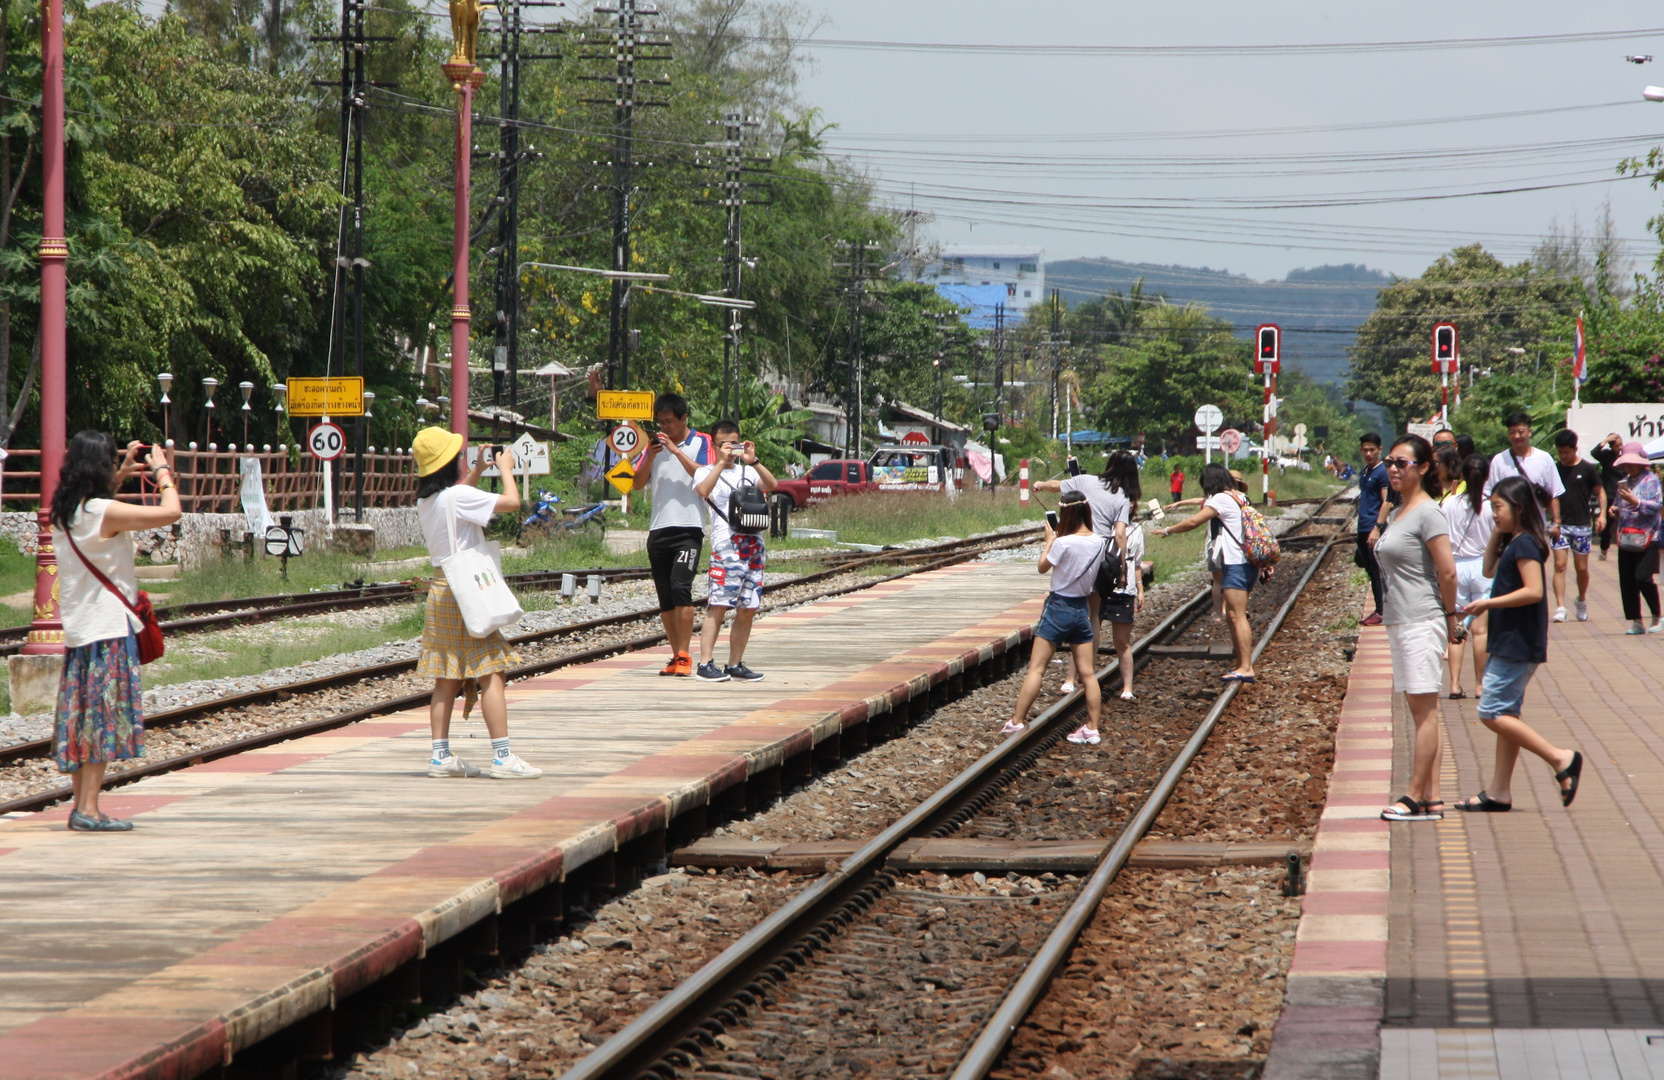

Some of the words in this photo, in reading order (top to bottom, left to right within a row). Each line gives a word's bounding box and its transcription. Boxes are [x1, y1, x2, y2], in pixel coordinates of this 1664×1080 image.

[313, 431, 341, 451] 60
[616, 431, 636, 446] 20
[677, 550, 689, 563] 21
[497, 748, 510, 758] 08
